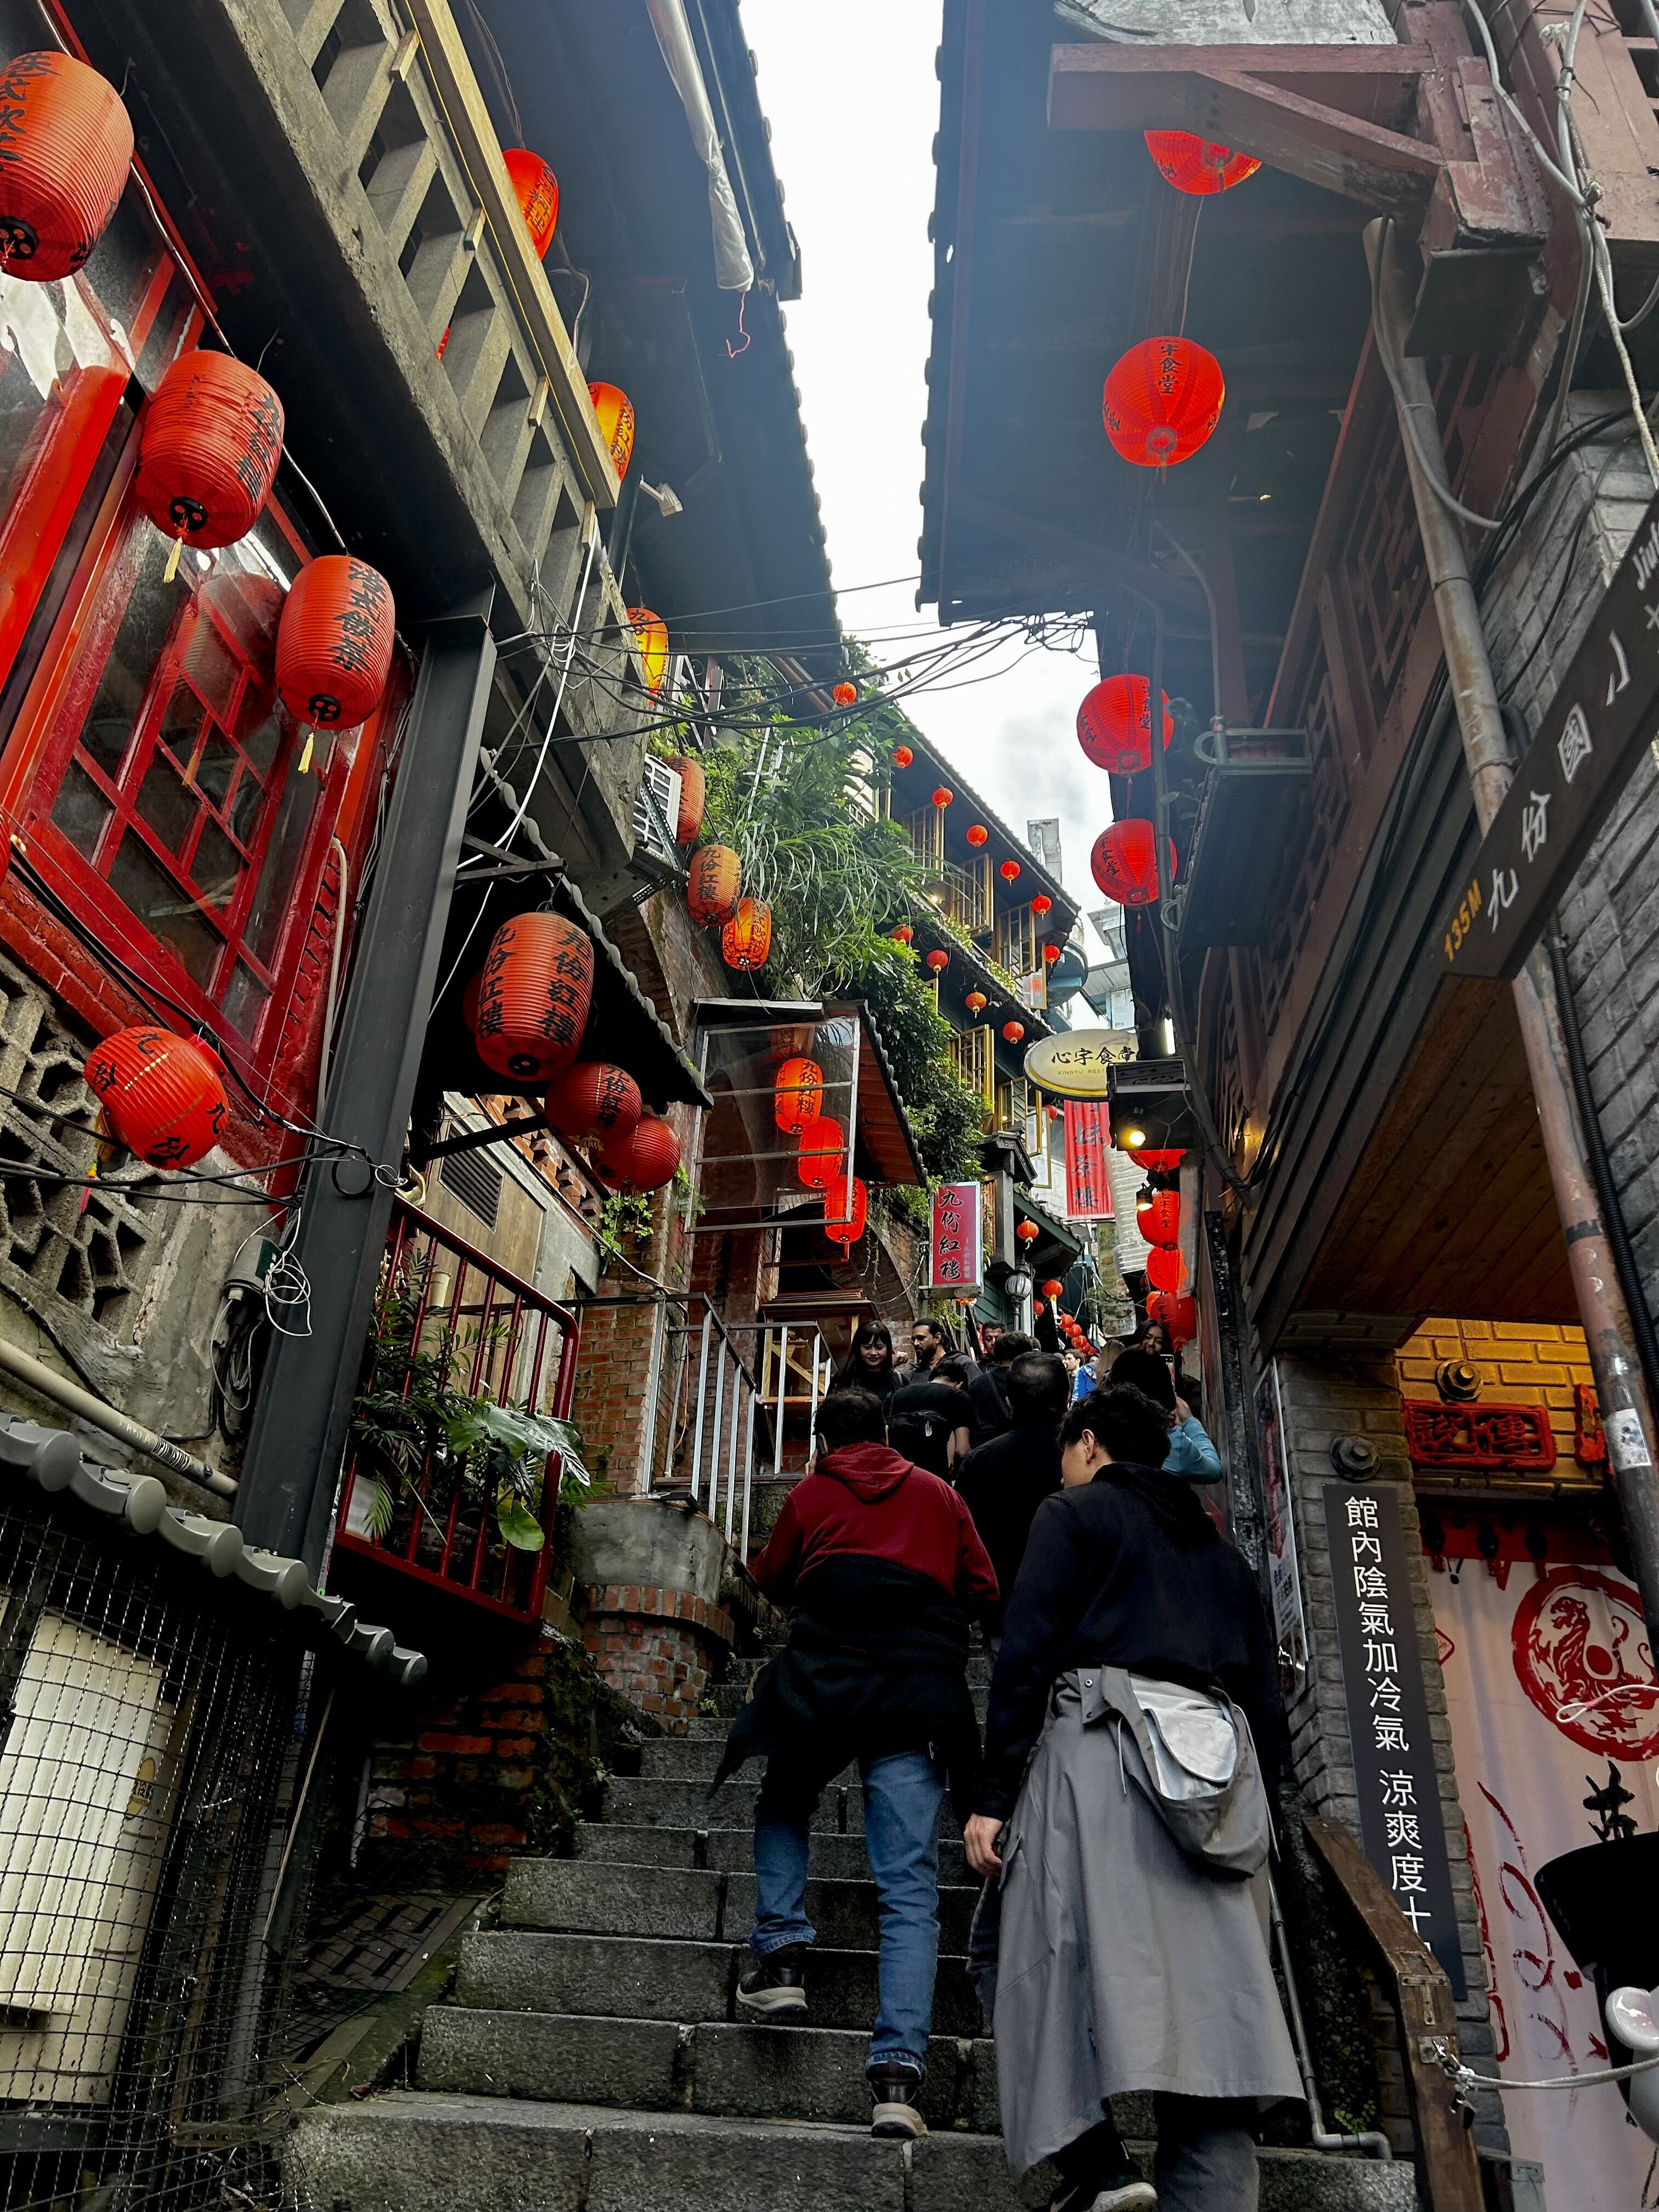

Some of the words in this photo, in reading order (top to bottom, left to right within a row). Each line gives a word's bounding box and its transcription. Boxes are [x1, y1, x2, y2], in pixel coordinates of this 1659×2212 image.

[938, 1190, 963, 1280] 九份紅樓
[1344, 1496, 1409, 1752] 館內陰氣加冷氣
[1379, 1769, 1431, 1953] 涼爽度十
